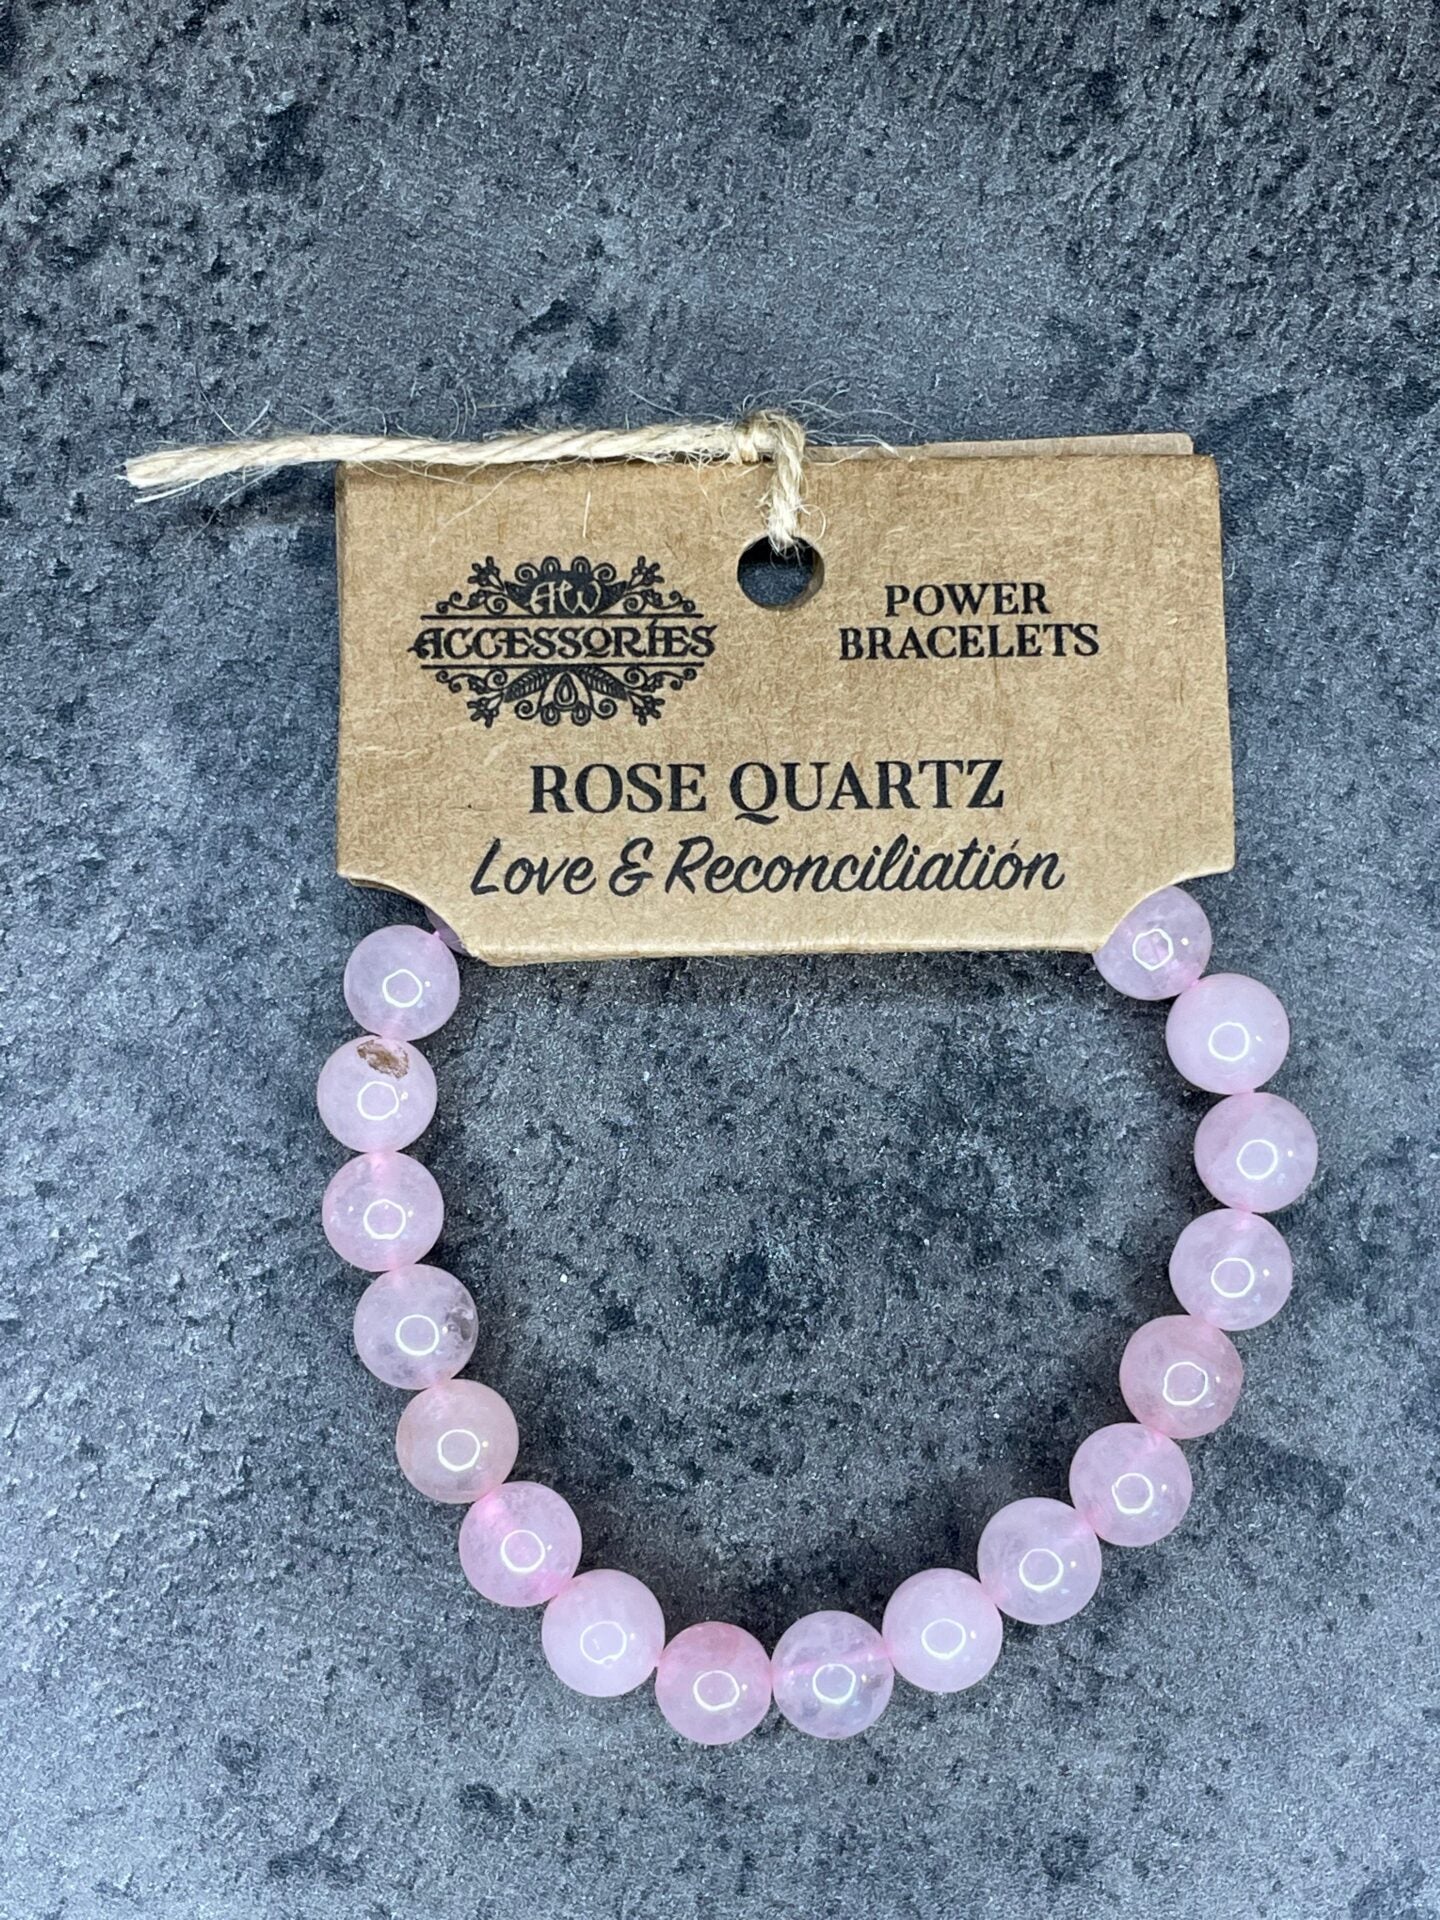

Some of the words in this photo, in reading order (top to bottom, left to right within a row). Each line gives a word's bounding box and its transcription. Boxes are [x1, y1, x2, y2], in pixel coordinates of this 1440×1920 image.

[884, 582, 1051, 617] POWER
[407, 620, 718, 660] ACCESSORIES
[838, 623, 1100, 660] BRACELETS
[529, 763, 707, 814] ROSE
[729, 759, 1005, 825] QUARTZ
[470, 837, 596, 897] Love
[608, 837, 653, 898] &
